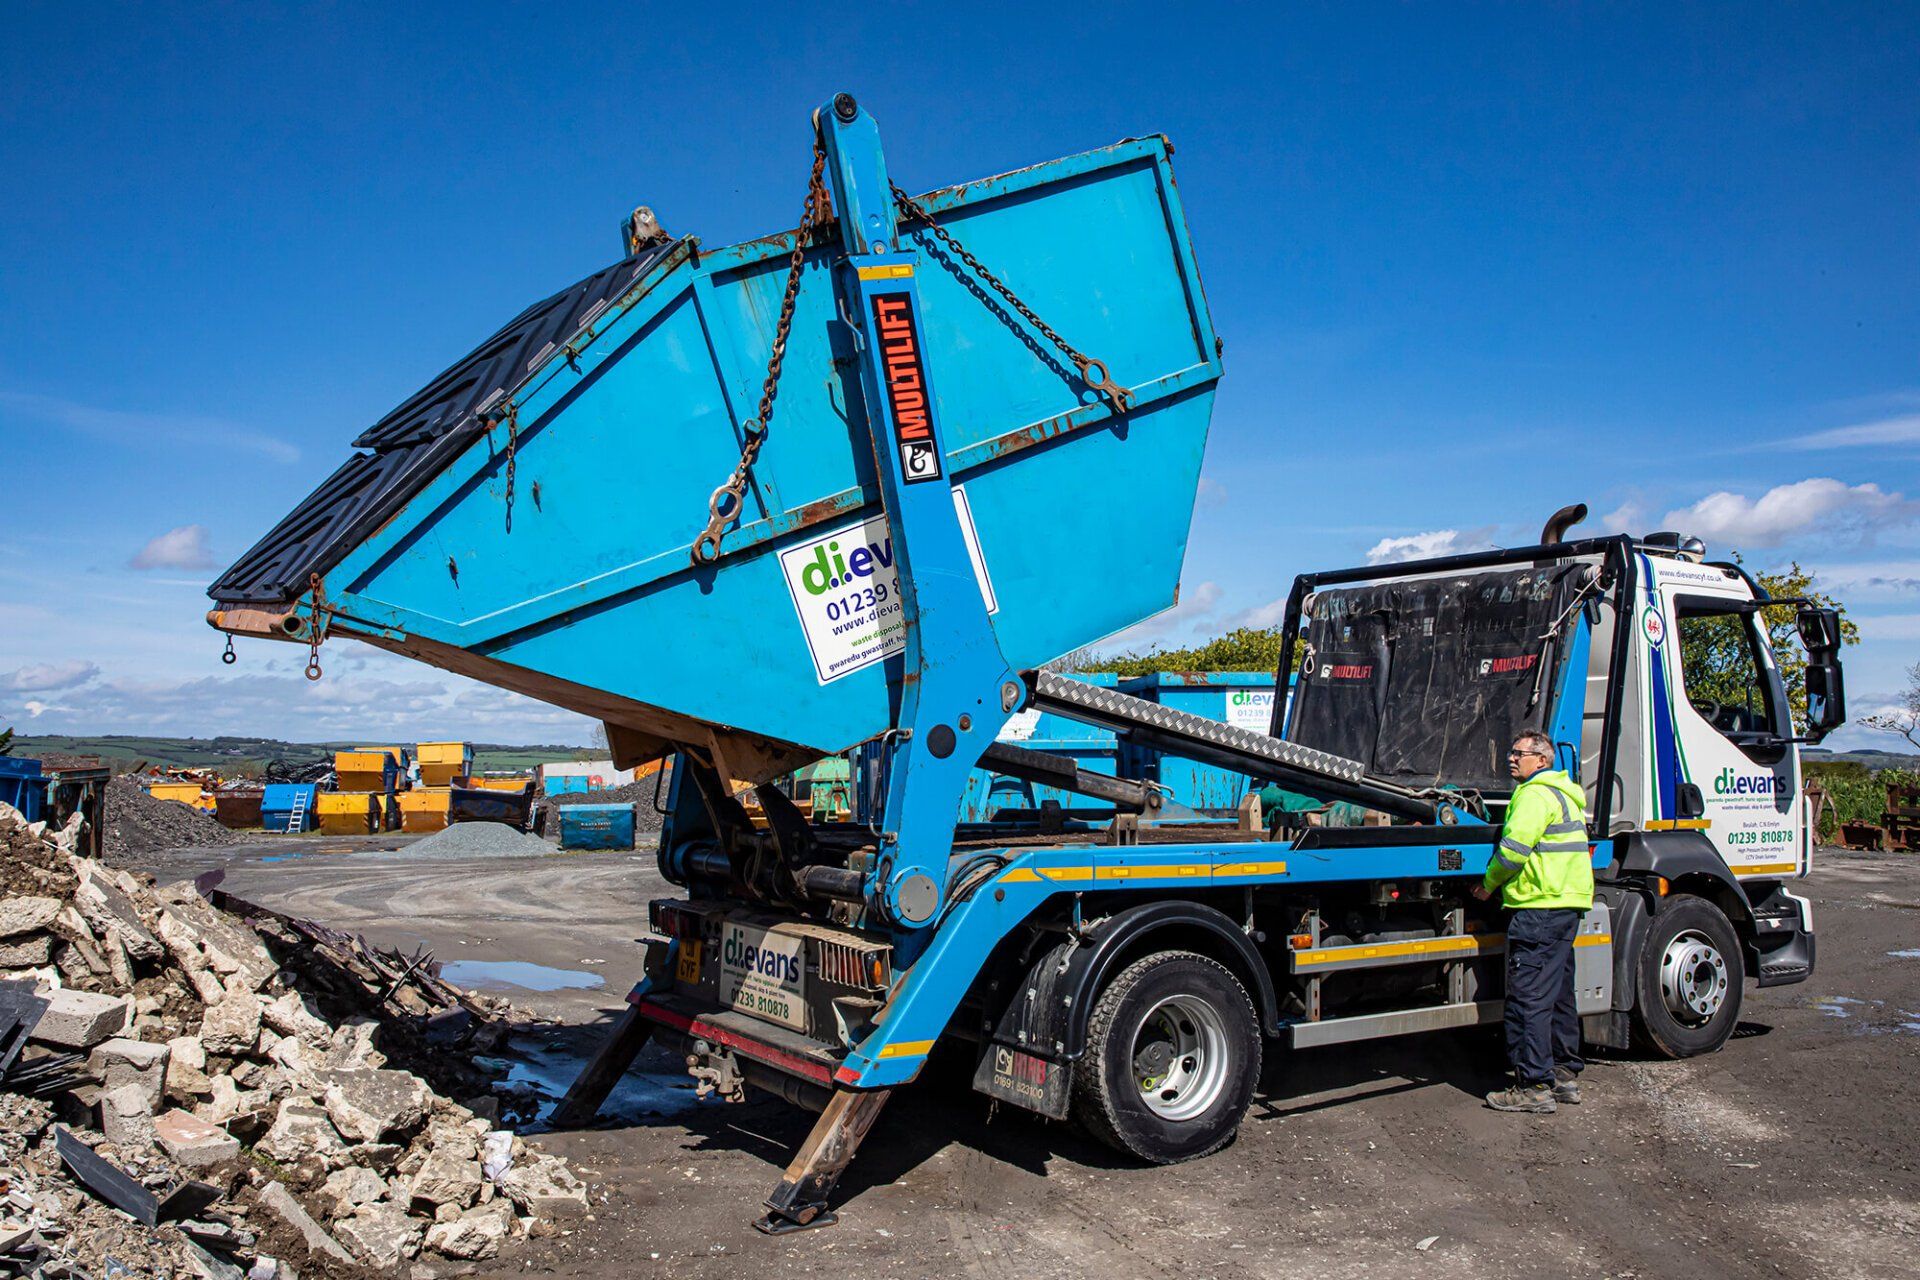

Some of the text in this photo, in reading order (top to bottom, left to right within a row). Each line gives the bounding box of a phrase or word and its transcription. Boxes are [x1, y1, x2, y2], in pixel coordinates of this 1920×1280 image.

[877, 299, 930, 439] MULTILIFT
[802, 538, 893, 596] d.i.ev
[826, 583, 888, 622] 01239
[832, 603, 900, 636] www.dieva
[829, 653, 861, 672] gwaredu
[861, 638, 896, 659] gwastraff,
[851, 634, 872, 647] waste
[1332, 665, 1373, 679] MULTILIFT
[1237, 709, 1264, 717] 01239
[1714, 767, 1787, 795] d.i.evans
[1728, 830, 1793, 844] 01239 810878
[680, 958, 696, 978] CYF
[725, 928, 799, 984] d.i.evans
[731, 988, 754, 1008] 01239
[757, 996, 789, 1019] 810878
